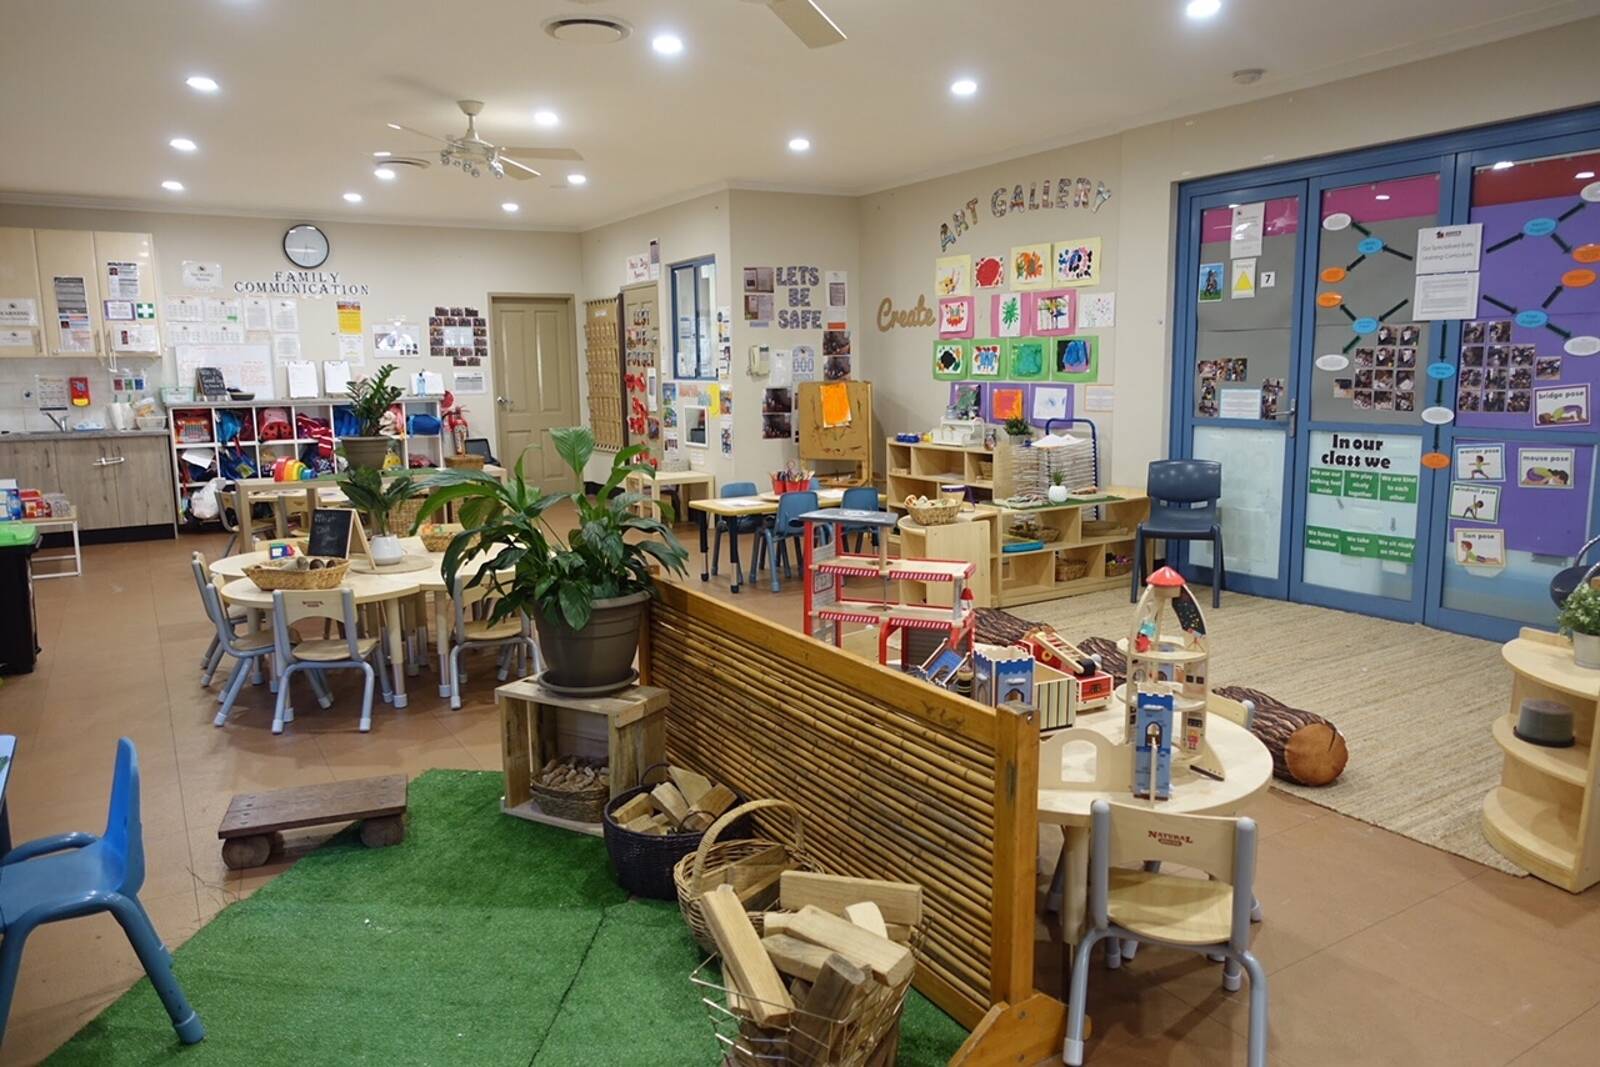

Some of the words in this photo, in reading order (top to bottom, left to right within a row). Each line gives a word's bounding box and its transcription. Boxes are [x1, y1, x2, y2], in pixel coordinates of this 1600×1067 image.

[939, 197, 978, 252] ART
[991, 177, 1112, 218] GALLERY
[274, 272, 340, 283] FAMILY
[776, 266, 820, 286] LETS
[1264, 274, 1271, 283] 7
[234, 281, 369, 295] COMMUNICATION
[788, 288, 811, 307] BE
[778, 310, 822, 329] SAFE
[877, 294, 936, 332] Create
[1538, 391, 1563, 400] bridge
[1565, 390, 1584, 398] pose
[1332, 434, 1350, 449] In
[1353, 439, 1383, 451] our
[1321, 450, 1360, 467] class
[1365, 456, 1391, 469] we
[1148, 830, 1193, 844] NATURAL
